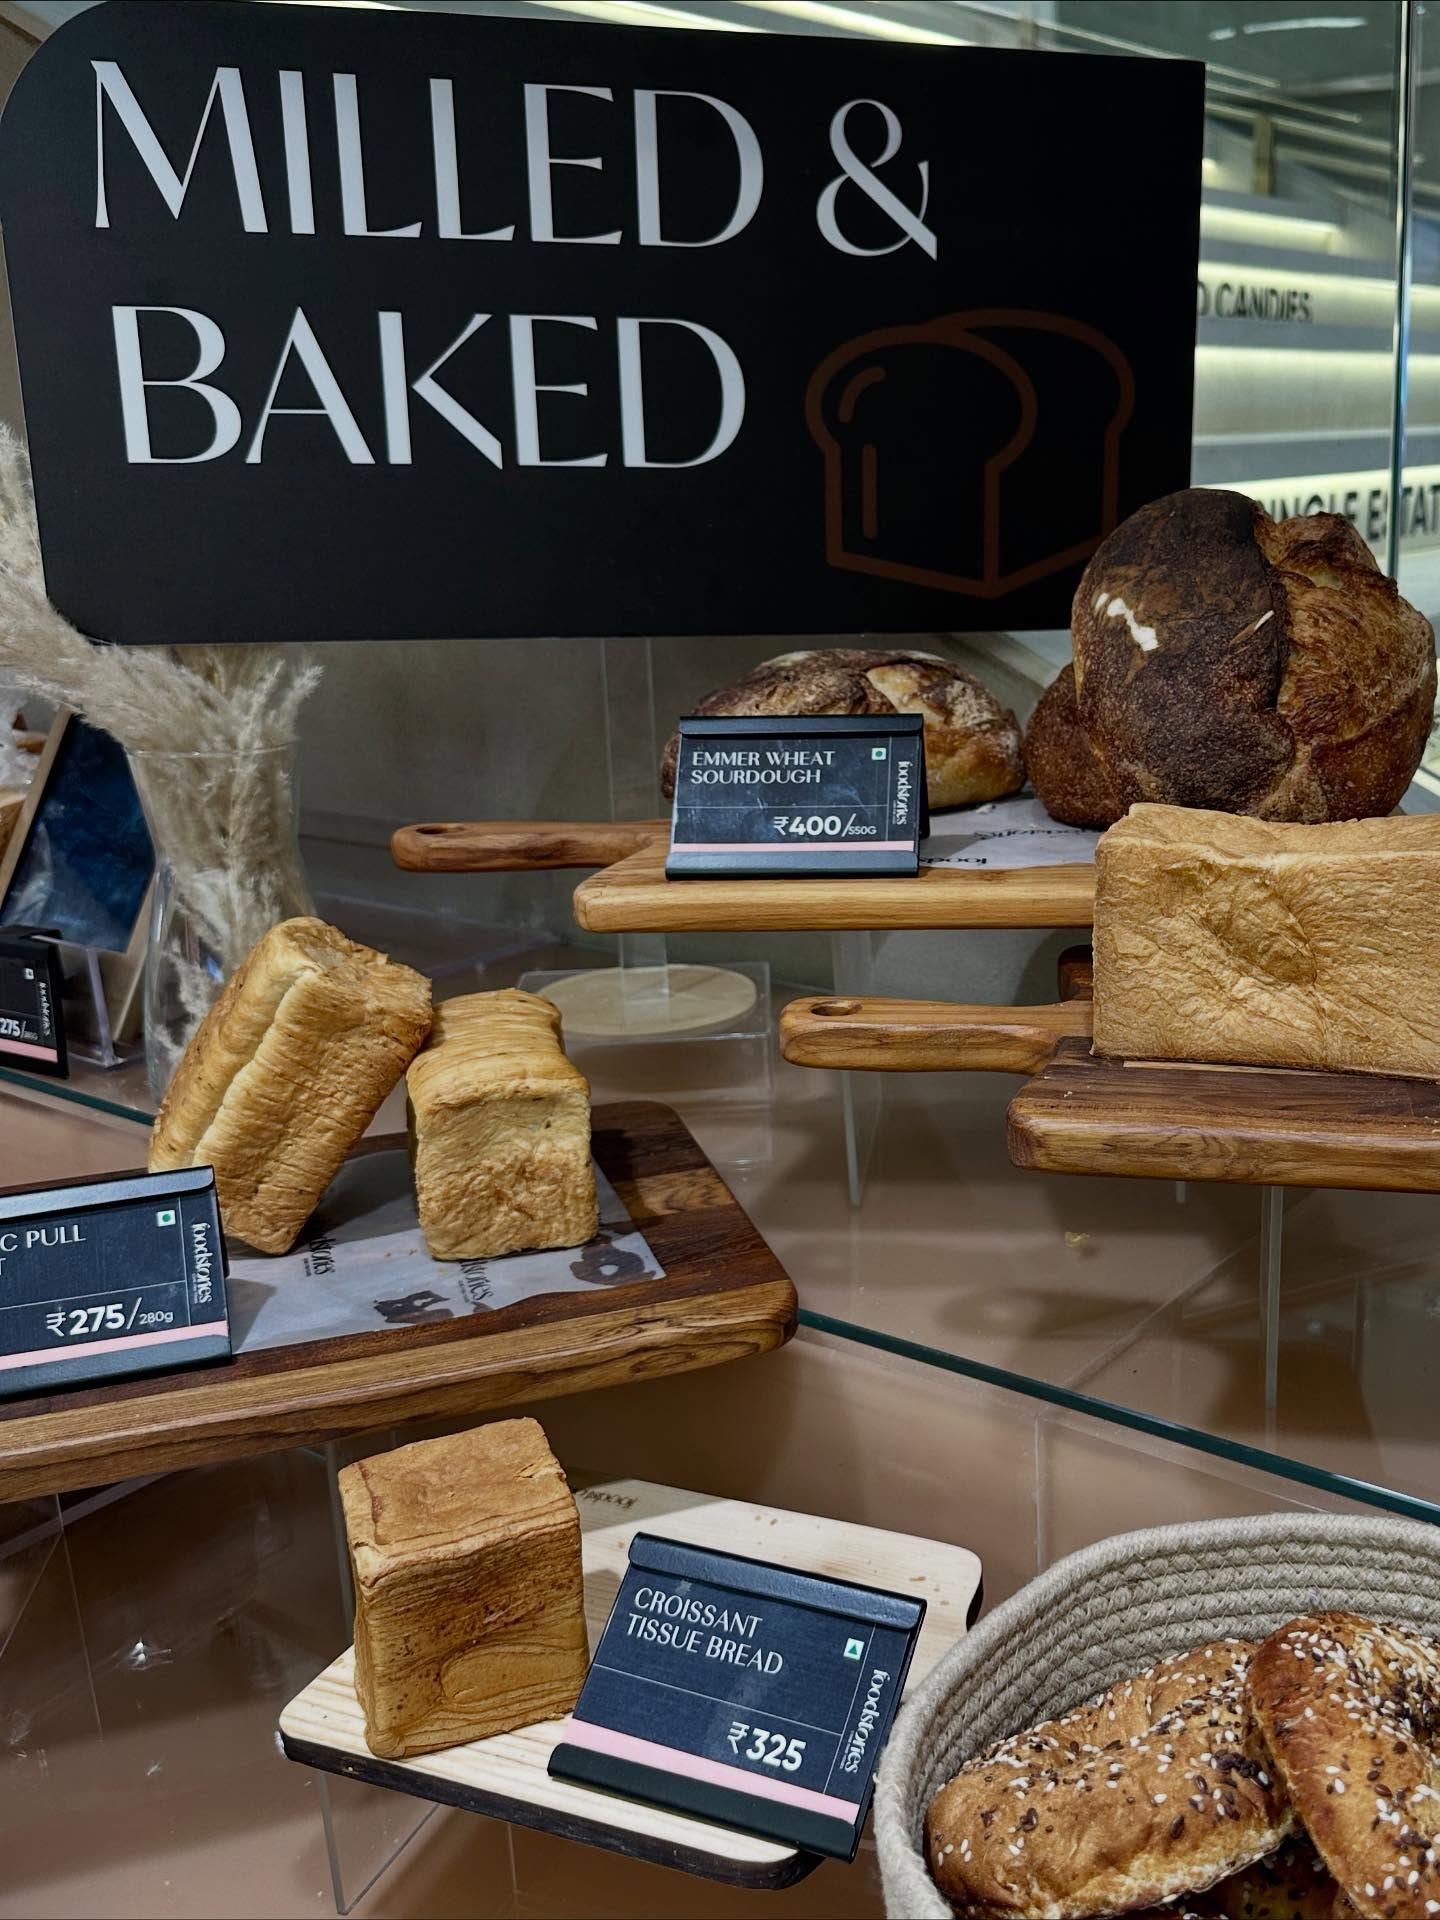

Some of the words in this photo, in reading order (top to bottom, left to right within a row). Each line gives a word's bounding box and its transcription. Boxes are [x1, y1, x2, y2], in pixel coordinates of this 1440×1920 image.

[91, 60, 763, 248] MILLED
[817, 99, 937, 261] &
[1215, 283, 1313, 322] CANDIES
[112, 305, 745, 469] BAKED
[691, 769, 821, 784] SOURDOUGH
[692, 751, 760, 766] EMMER
[766, 750, 835, 766] WHEAT
[896, 761, 914, 825] foodstories
[26, 1224, 86, 1249] PULL
[192, 1222, 213, 1304] foodstories
[634, 1587, 763, 1638] CROISSANT
[627, 1612, 703, 1654] TISSUE
[706, 1635, 784, 1674] BREAD
[727, 1721, 807, 1772] ₹325
[844, 1668, 891, 1774] foodstories
